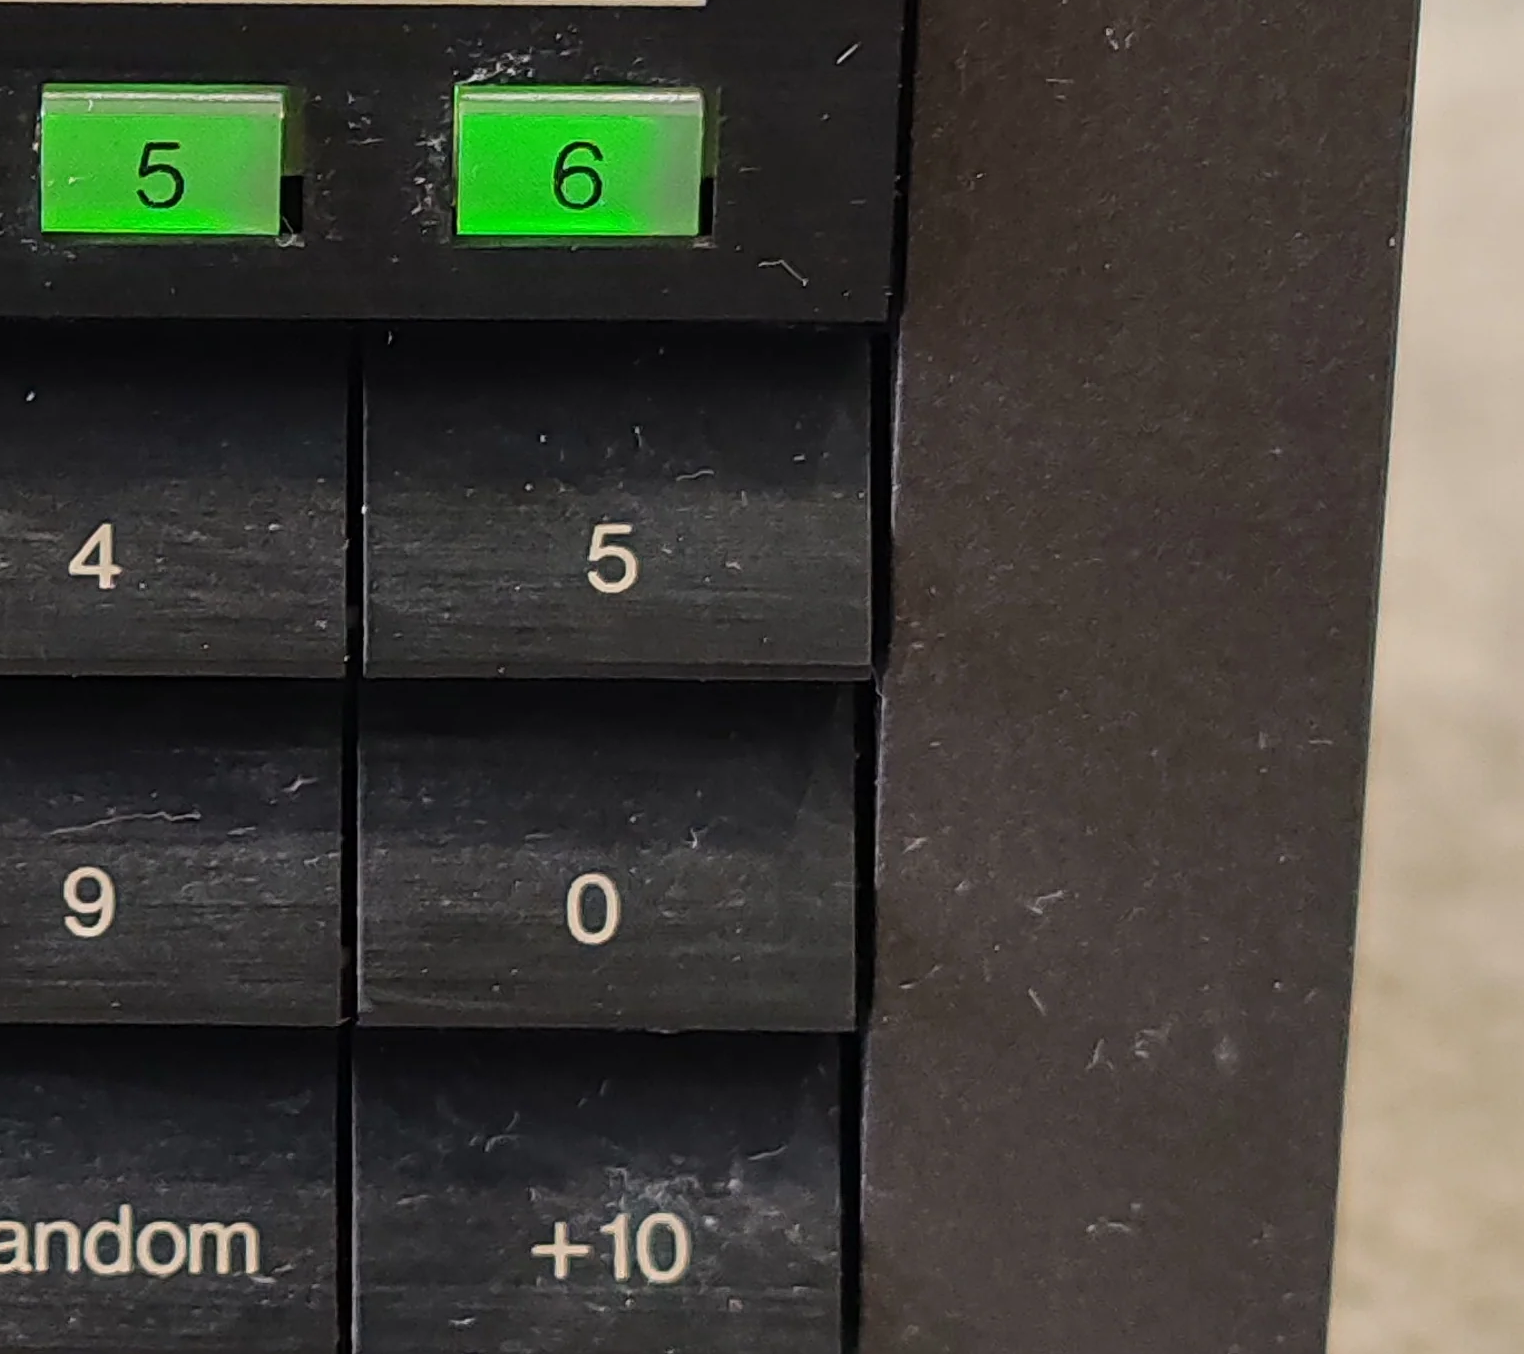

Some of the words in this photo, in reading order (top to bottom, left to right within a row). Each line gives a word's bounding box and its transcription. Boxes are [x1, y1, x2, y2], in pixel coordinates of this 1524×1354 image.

[135, 141, 185, 209] 5
[552, 141, 603, 210] 6
[67, 522, 122, 589] 4
[585, 522, 639, 594] 5
[62, 865, 117, 939] 9
[565, 873, 622, 946] 0
[531, 1211, 692, 1284] +10
